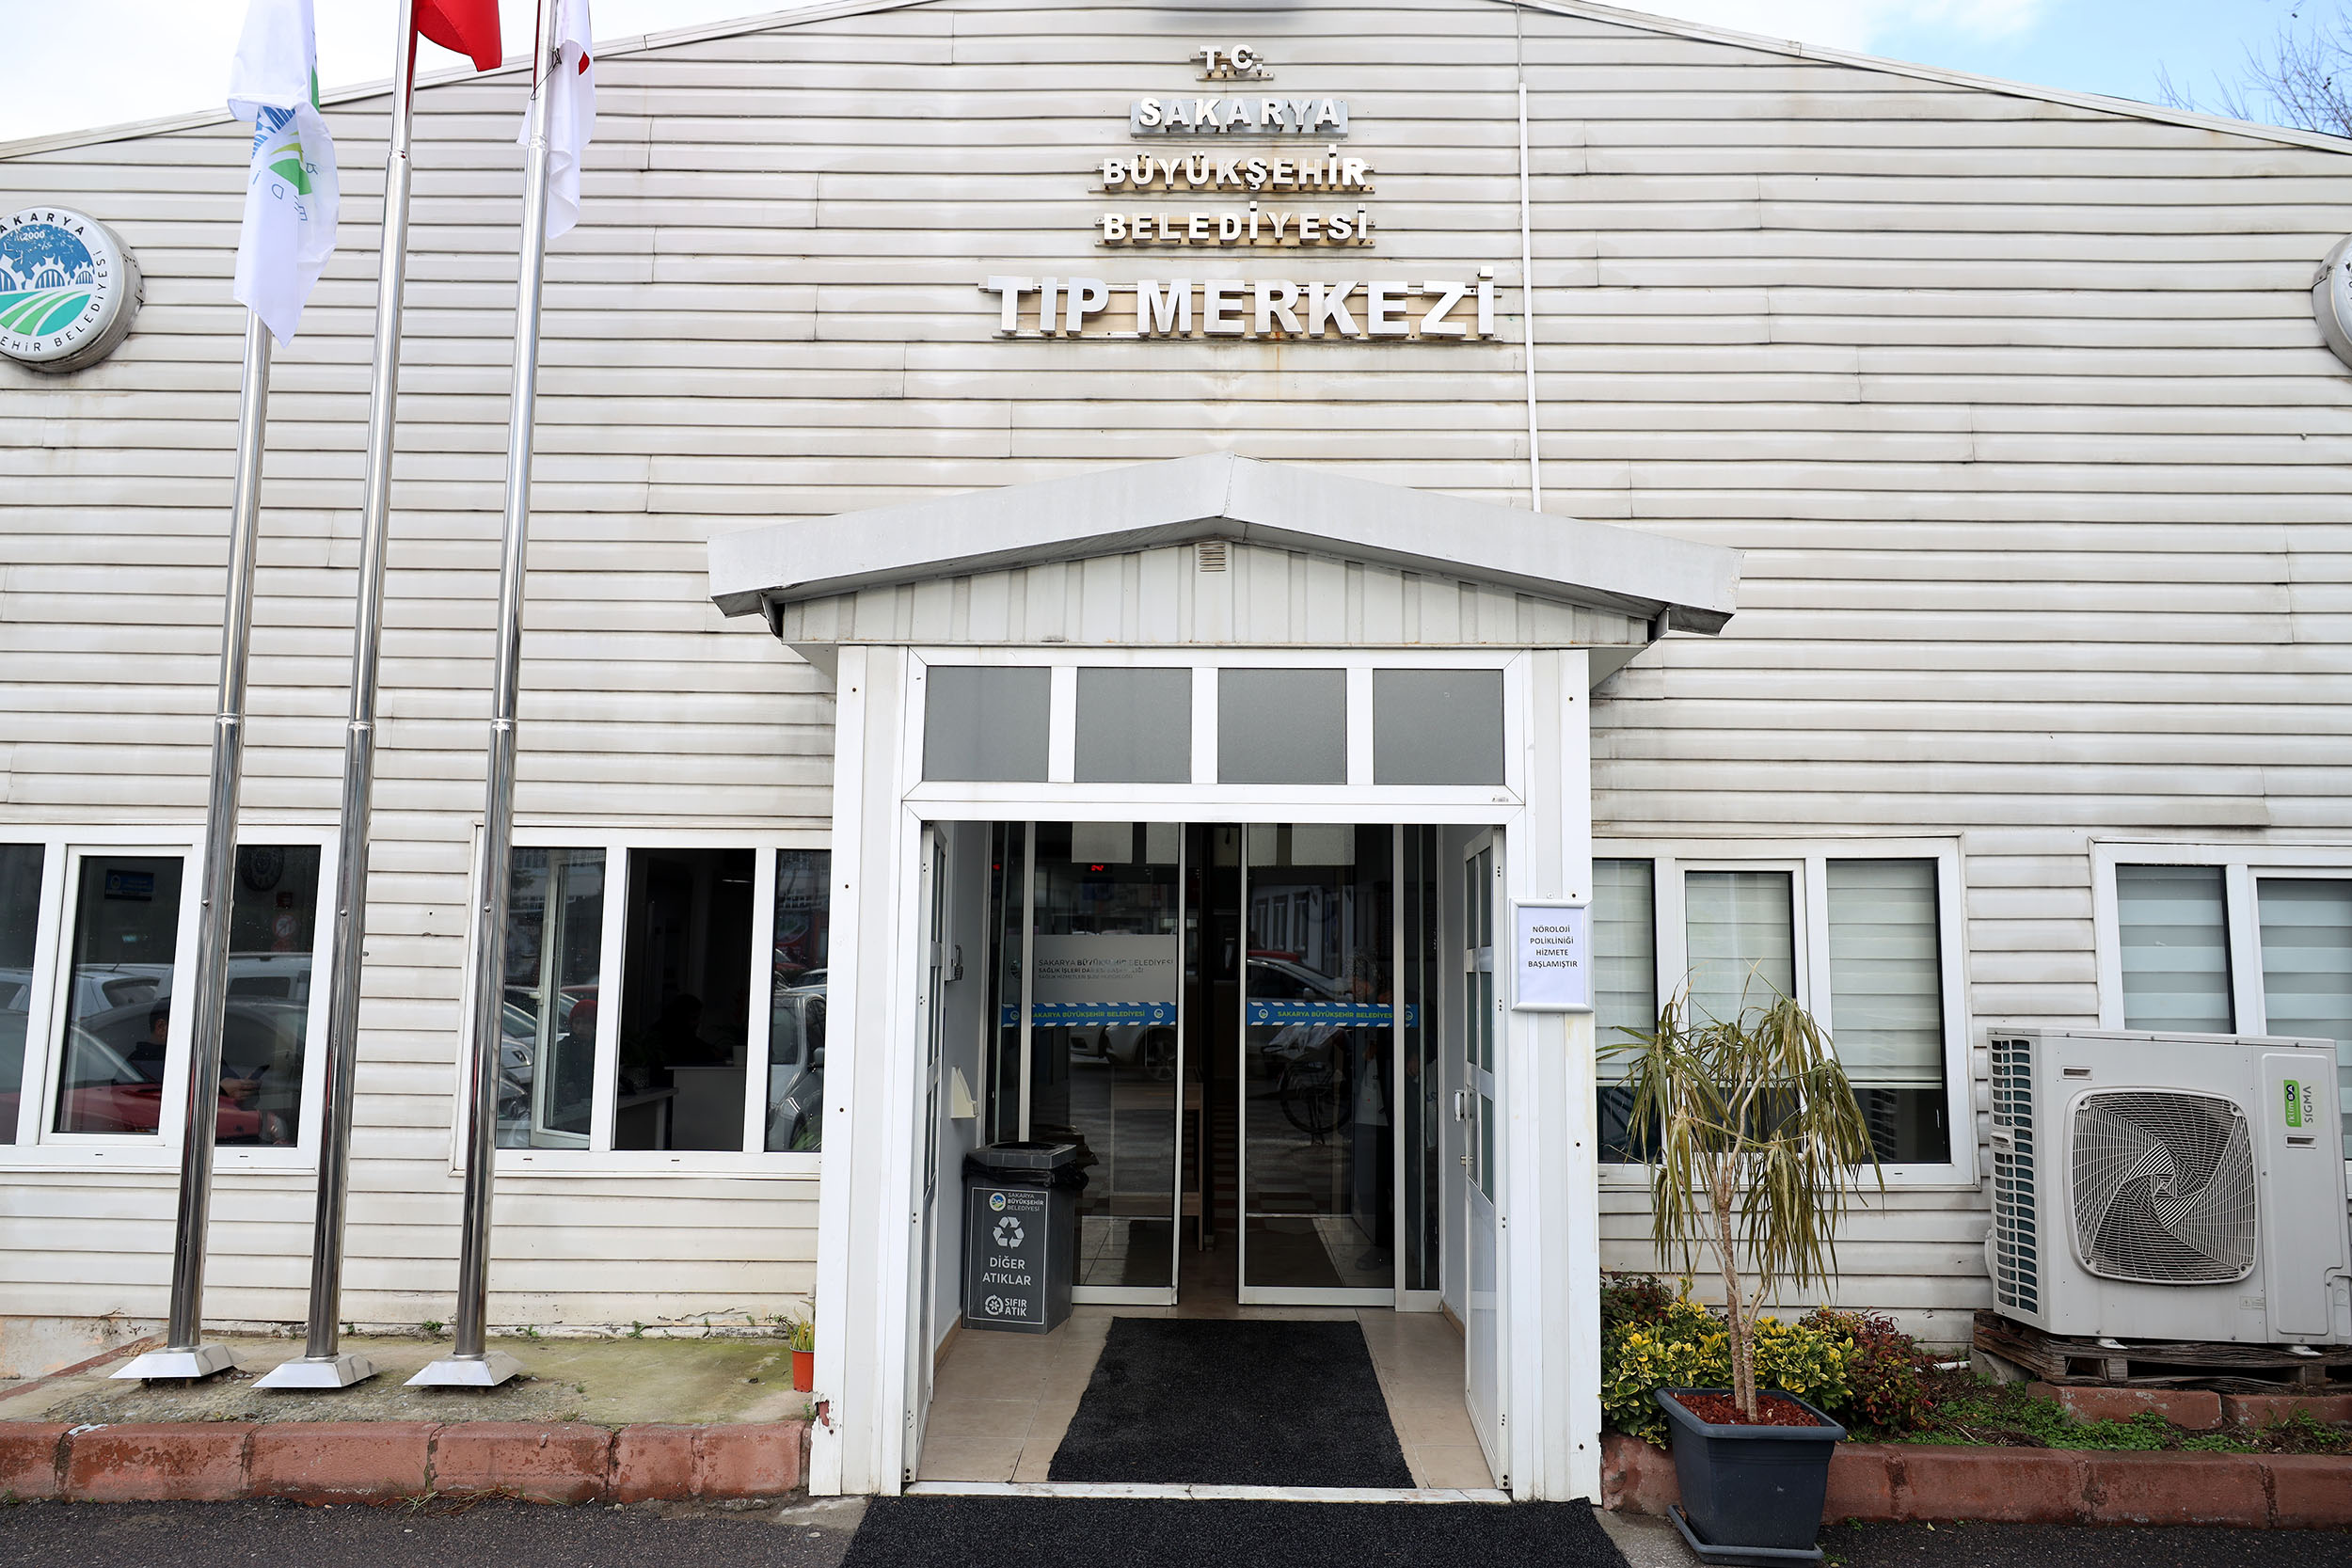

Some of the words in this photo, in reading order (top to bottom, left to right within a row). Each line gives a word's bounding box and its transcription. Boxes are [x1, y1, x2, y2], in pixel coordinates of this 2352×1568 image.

[1200, 44, 1263, 74] T.C.
[1138, 96, 1341, 132] SAKARYA
[1102, 143, 1368, 190] BÜYÜKŞEHİR
[0, 213, 85, 237] AKARYA
[1103, 200, 1369, 242] BELEDİYESİ
[23, 231, 45, 241] 2000
[987, 276, 1109, 334] TIP
[1136, 265, 1495, 336] MERKEZİ
[1533, 925, 1570, 933] NÖROLOJİ
[1530, 936, 1574, 944] POLİKLİNİĞİ
[1535, 947, 1568, 956] HİZMETE
[1038, 958, 1076, 967] SAKARYA
[1528, 960, 1578, 969] BAŞLAMIŞTIR
[1062, 1010, 1105, 1019] BÜYÜKŞEHİR
[1106, 1009, 1146, 1018] BELEDİYESİ
[1311, 1010, 1355, 1019] BÜYÜKŞEHİR
[2303, 1085, 2313, 1123] SIGMA
[1007, 1198, 1044, 1207] BÜYÜKŞEHİR
[989, 1255, 1025, 1270] DİĞER
[982, 1272, 1032, 1286] ATIKLAR
[1004, 1298, 1027, 1307] SIFIR
[1004, 1307, 1027, 1317] ATIK
